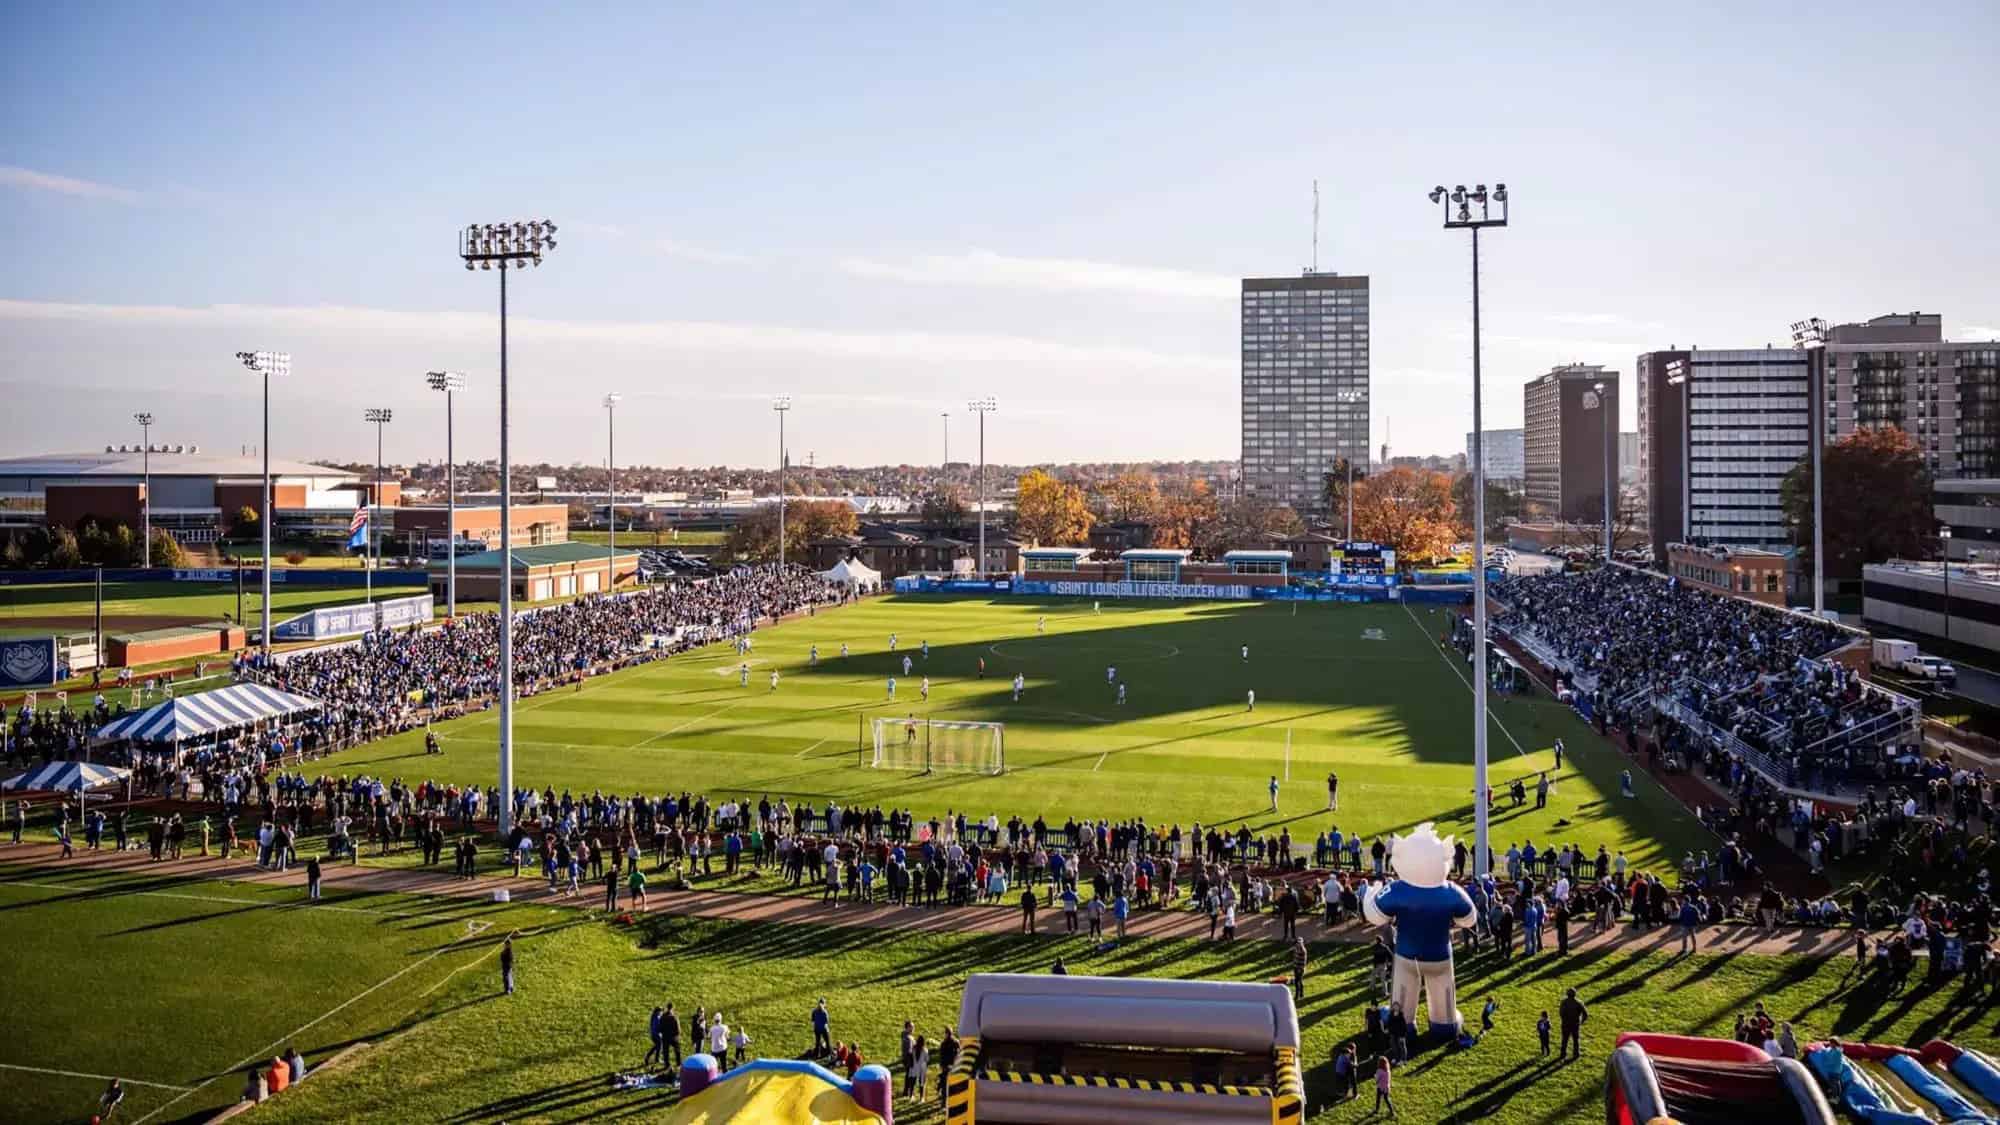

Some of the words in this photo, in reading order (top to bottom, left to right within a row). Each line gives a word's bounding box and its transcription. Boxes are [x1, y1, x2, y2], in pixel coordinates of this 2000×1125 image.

[1057, 581, 1088, 595] SAINT
[1089, 582, 1118, 596] LOUIS
[1120, 583, 1172, 597] BILLIKENS
[1173, 584, 1215, 598] SOCCER
[289, 622, 309, 634] SLU
